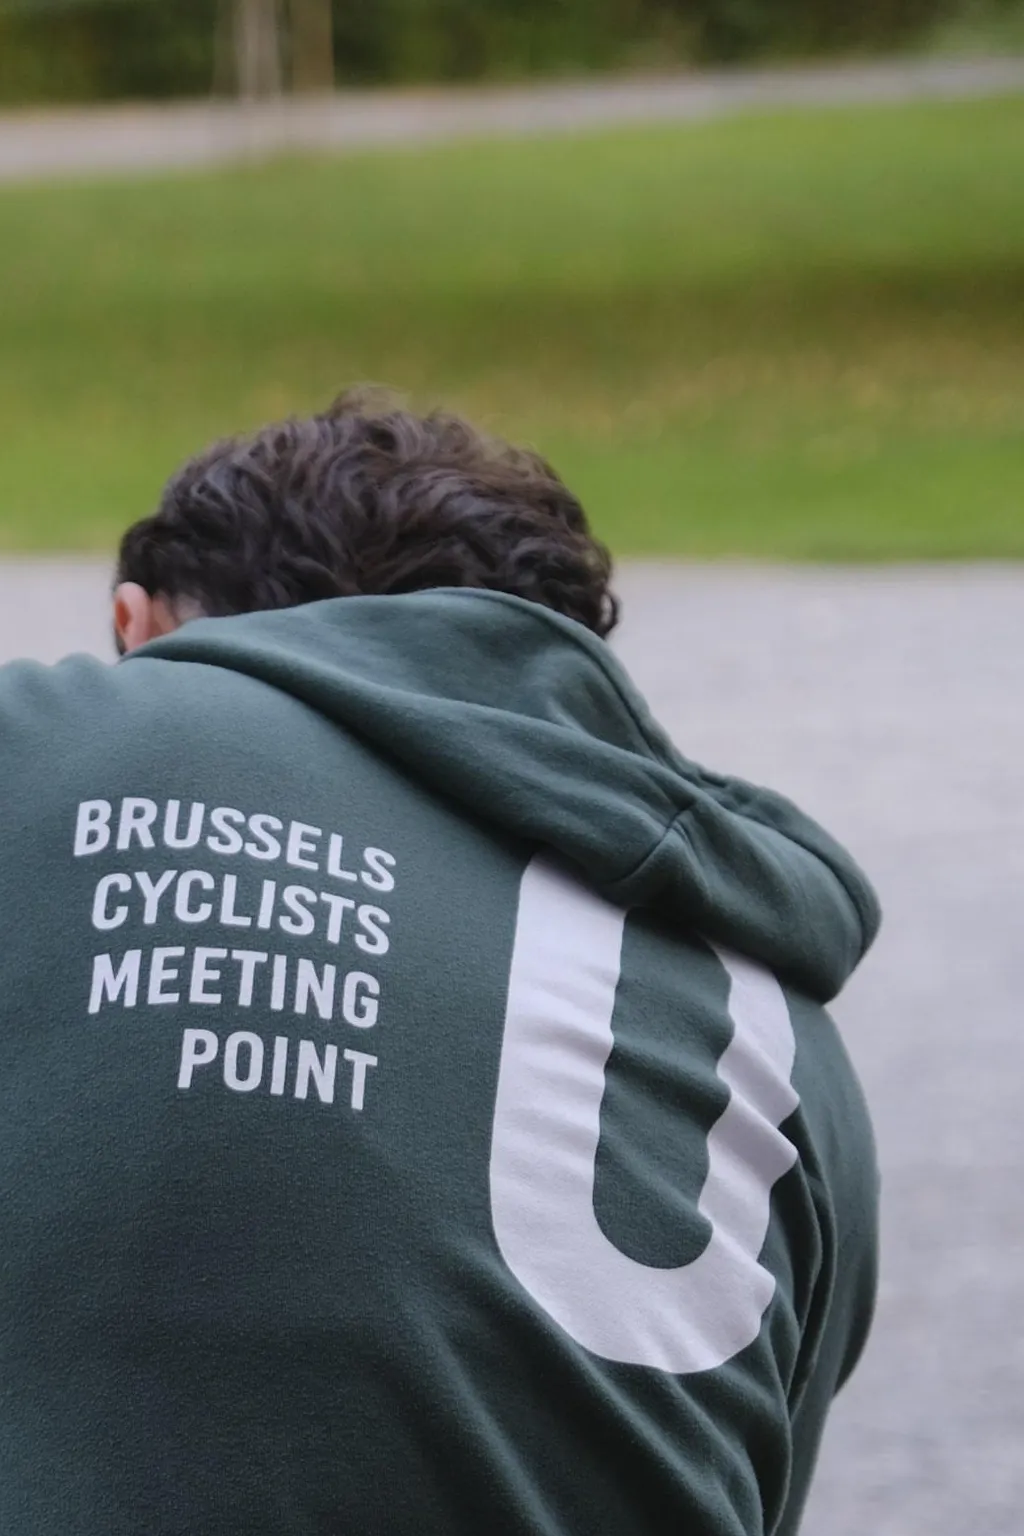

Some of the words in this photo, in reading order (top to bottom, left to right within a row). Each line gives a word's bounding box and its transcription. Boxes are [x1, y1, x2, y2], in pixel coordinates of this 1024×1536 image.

[73, 797, 396, 891] BRUSSELS
[91, 869, 391, 954] CYCLISTS
[88, 946, 380, 1028] MEETING
[177, 1028, 378, 1110] POINT
